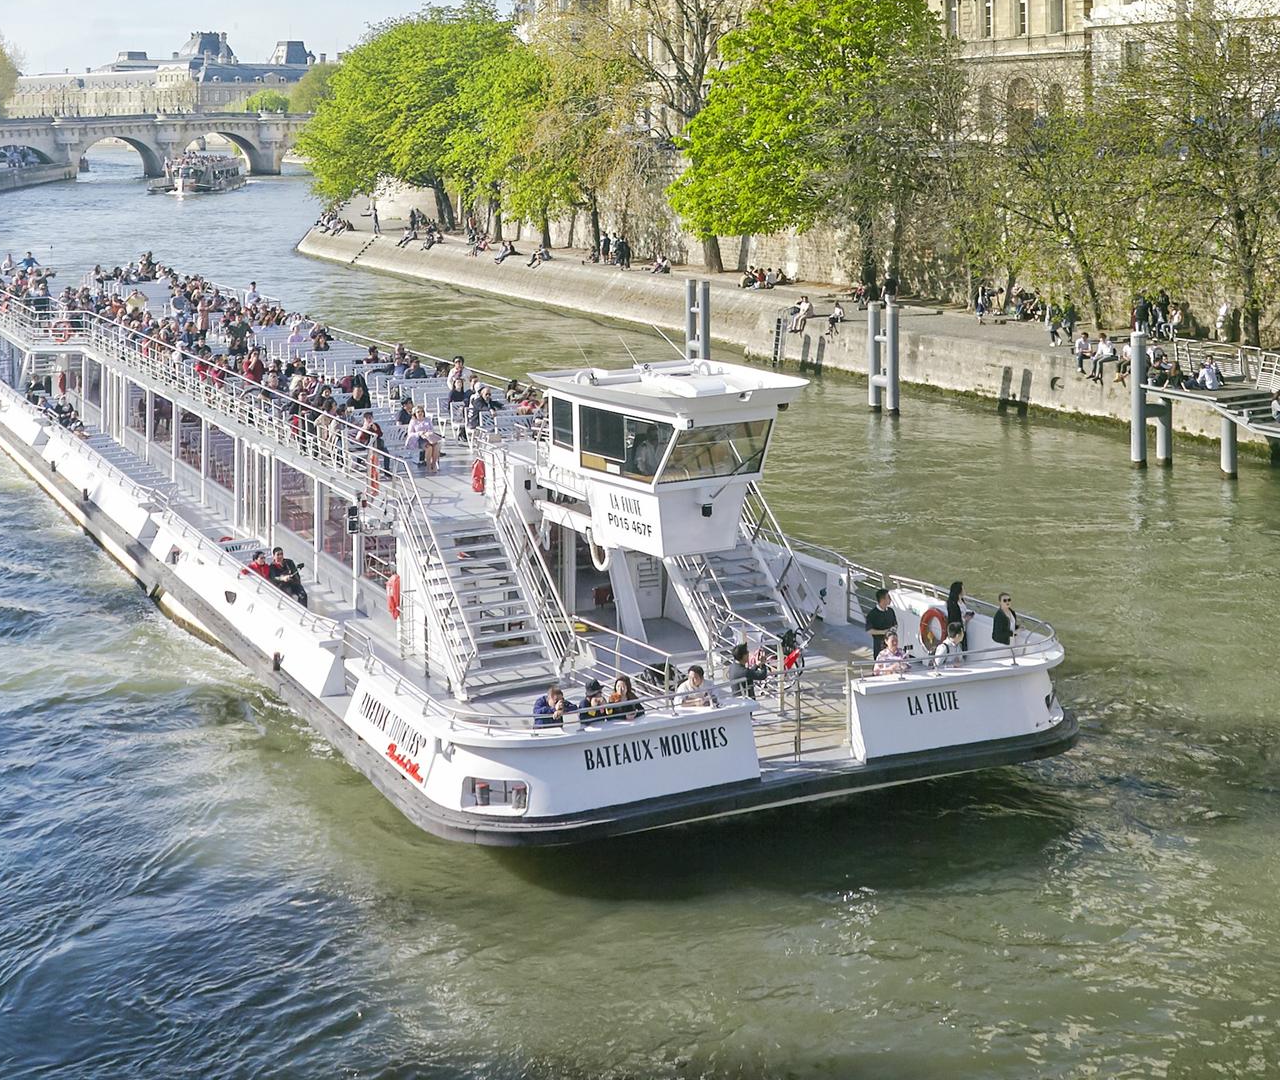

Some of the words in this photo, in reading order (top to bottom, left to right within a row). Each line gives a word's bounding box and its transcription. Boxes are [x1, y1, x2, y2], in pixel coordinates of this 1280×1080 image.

[609, 492, 620, 510] LA
[631, 520, 653, 538] 467F
[907, 695, 924, 716] LA
[926, 690, 960, 713] FLUTE
[583, 726, 729, 771] BATEAUX-MOUCHES
